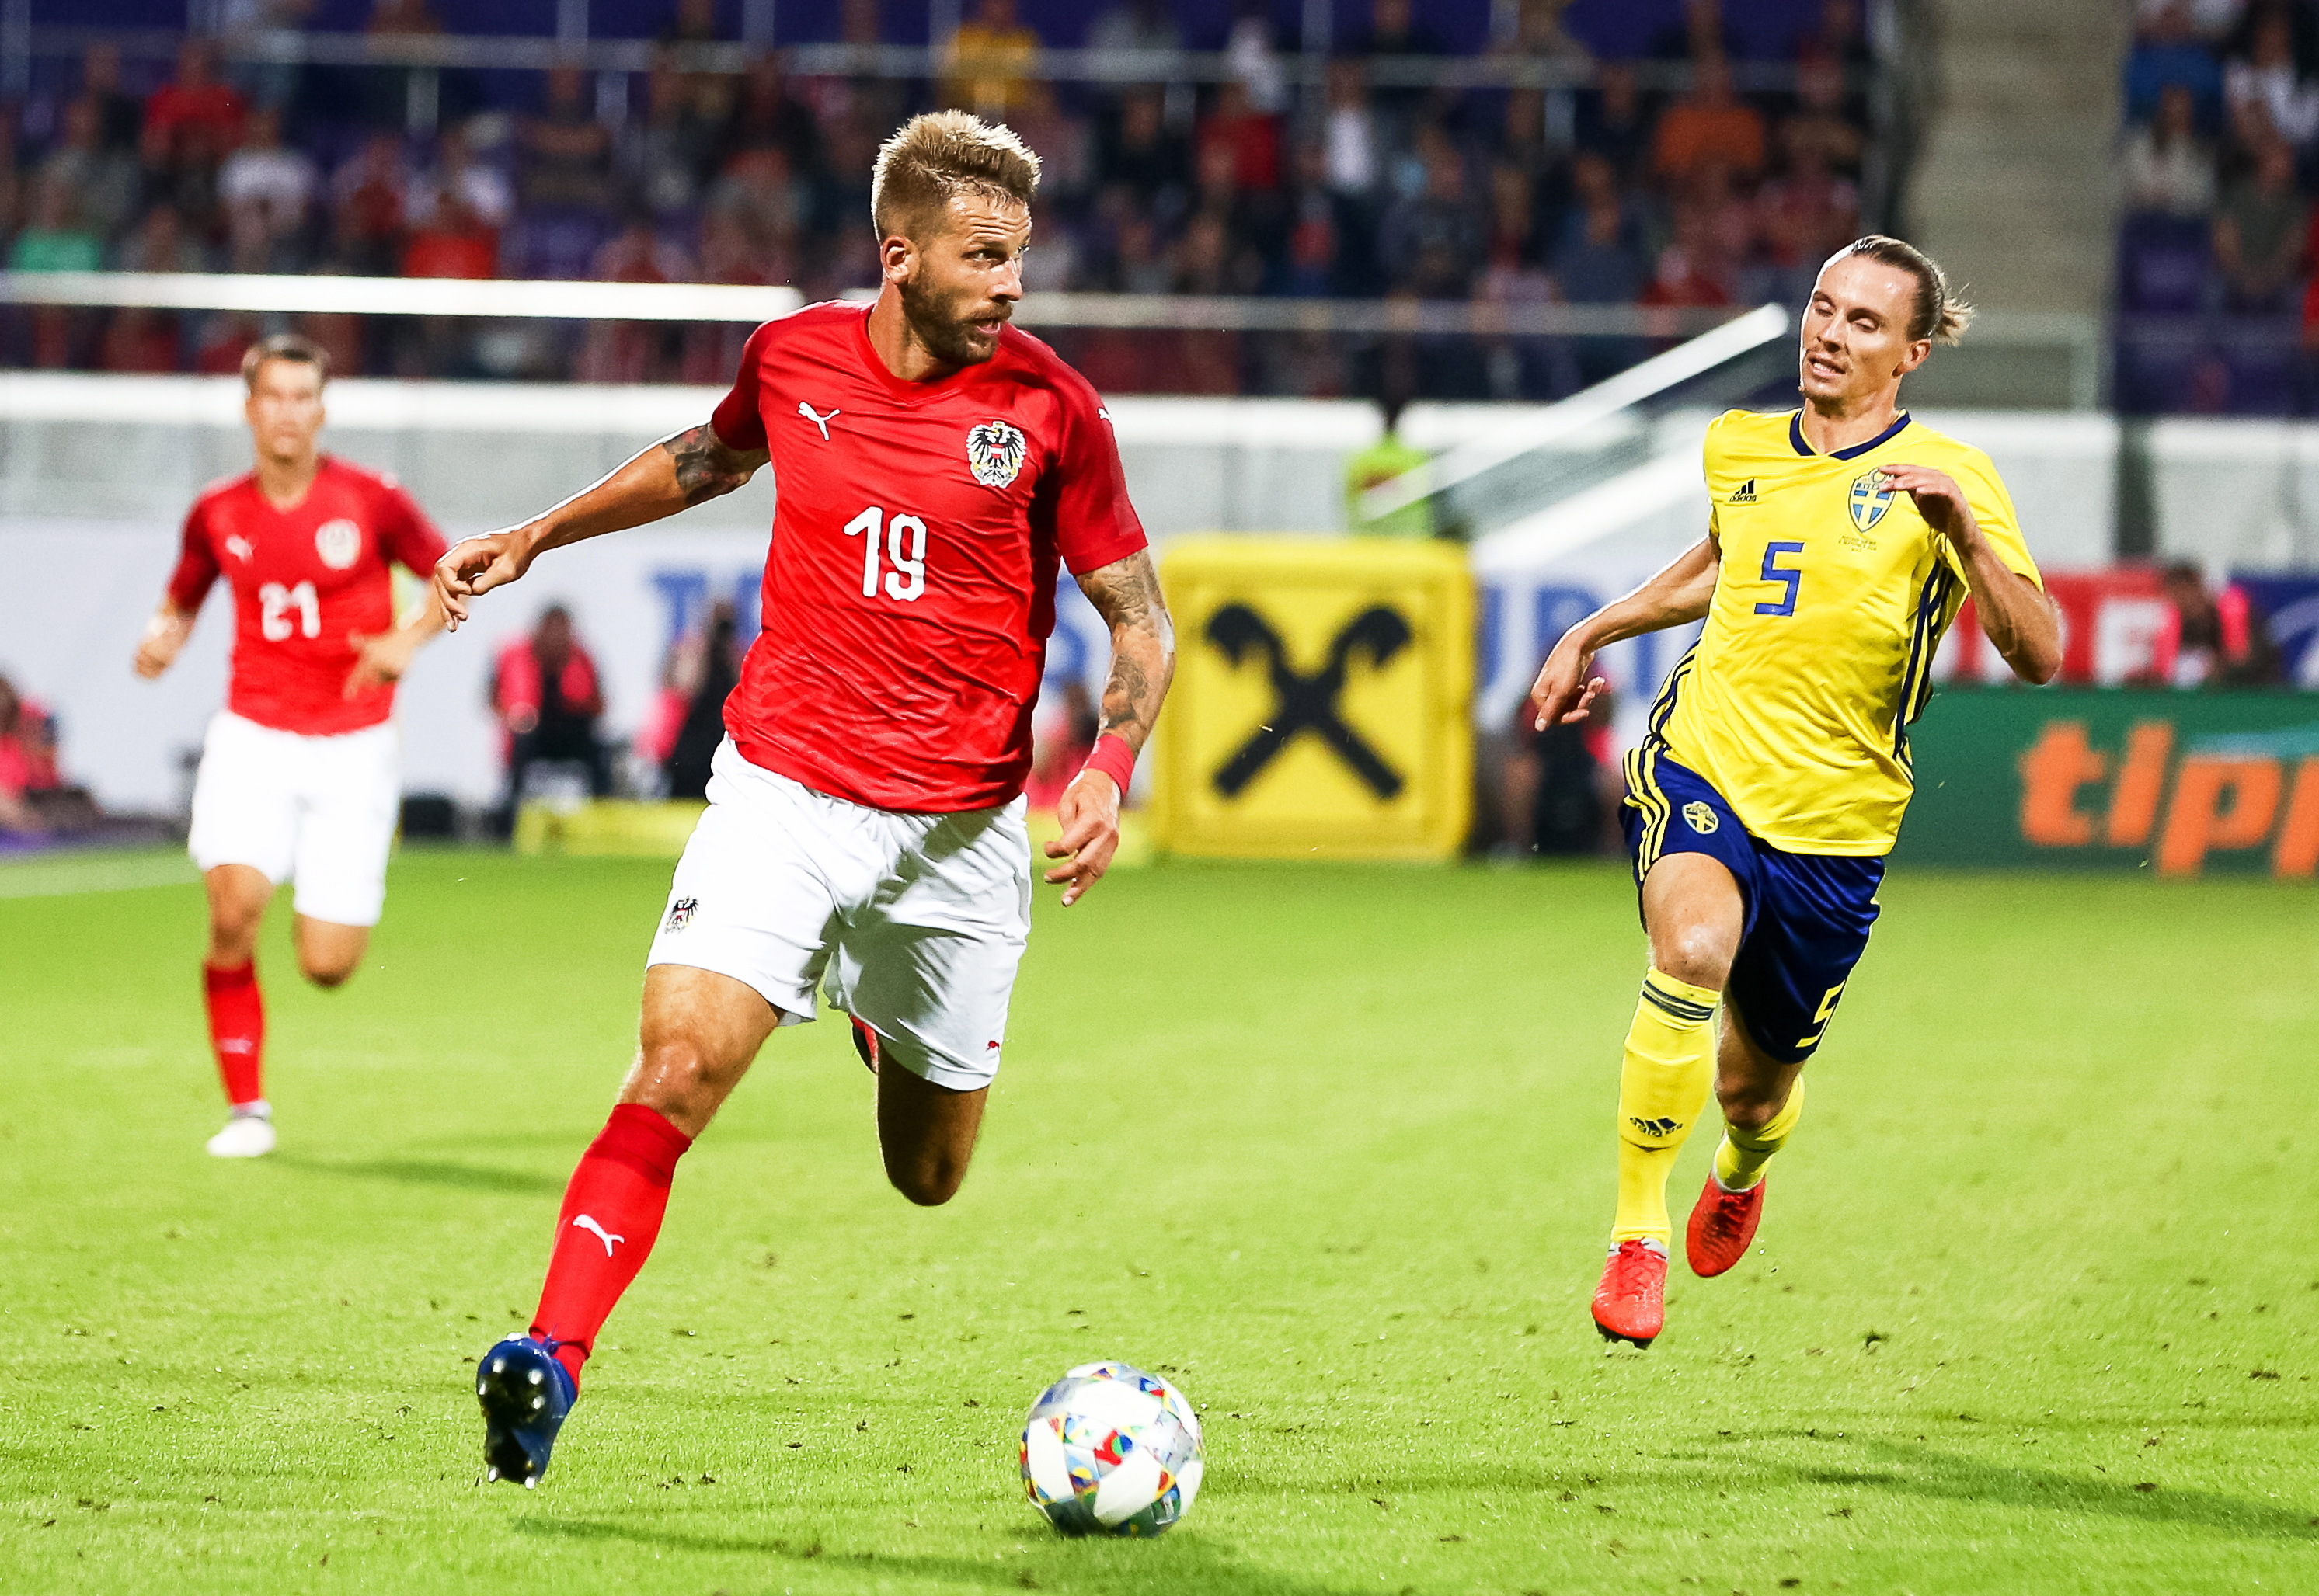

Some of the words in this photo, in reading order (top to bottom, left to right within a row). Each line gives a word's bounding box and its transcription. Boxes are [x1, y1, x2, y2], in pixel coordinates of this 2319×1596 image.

[843, 506, 927, 602] 19
[1754, 541, 1805, 617] 5
[259, 581, 322, 642] 21
[1795, 979, 1846, 1048] 5
